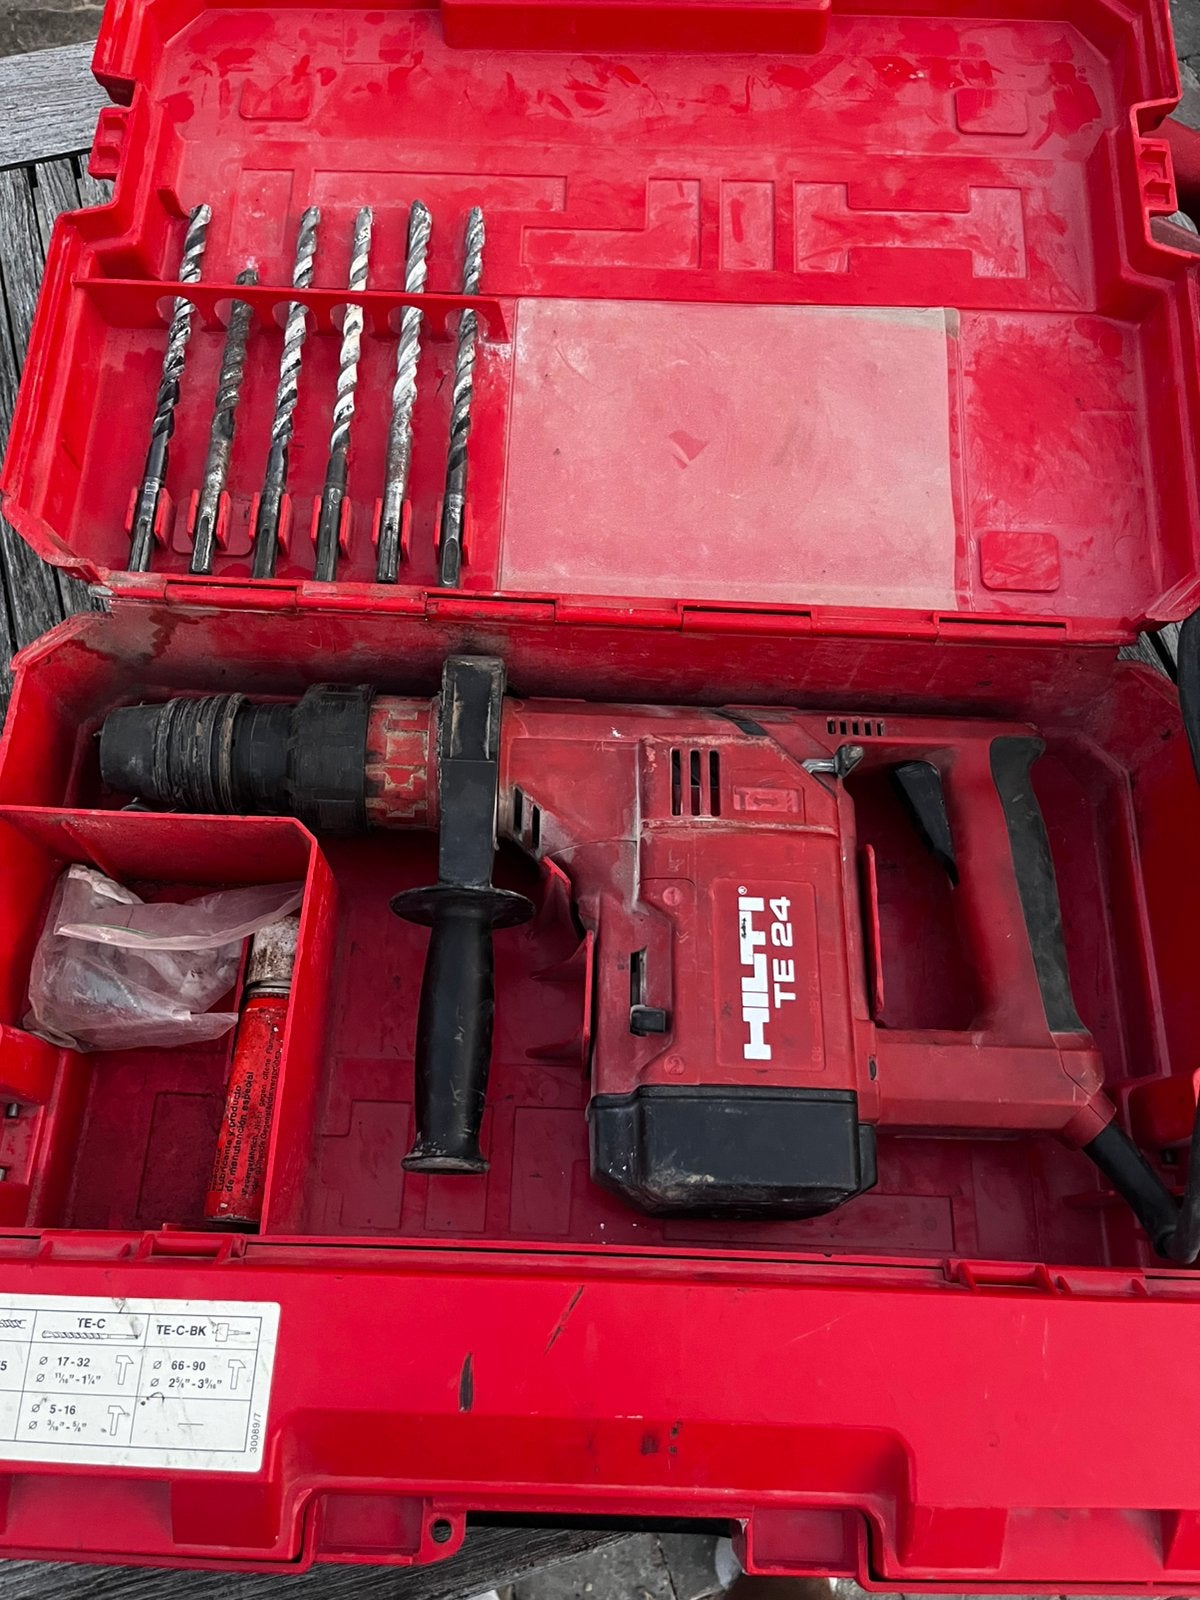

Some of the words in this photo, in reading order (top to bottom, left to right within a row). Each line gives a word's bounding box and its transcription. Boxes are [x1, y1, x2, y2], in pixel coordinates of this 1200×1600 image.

[769, 895, 793, 947] 24
[738, 896, 772, 1060] HILTI
[772, 958, 797, 1009] TE
[226, 1179, 234, 1192] de
[242, 1071, 254, 1111] especial
[77, 1317, 106, 1329] TE-C
[157, 1324, 207, 1336] TE-C-BK
[250, 1412, 262, 1454] 30089/7
